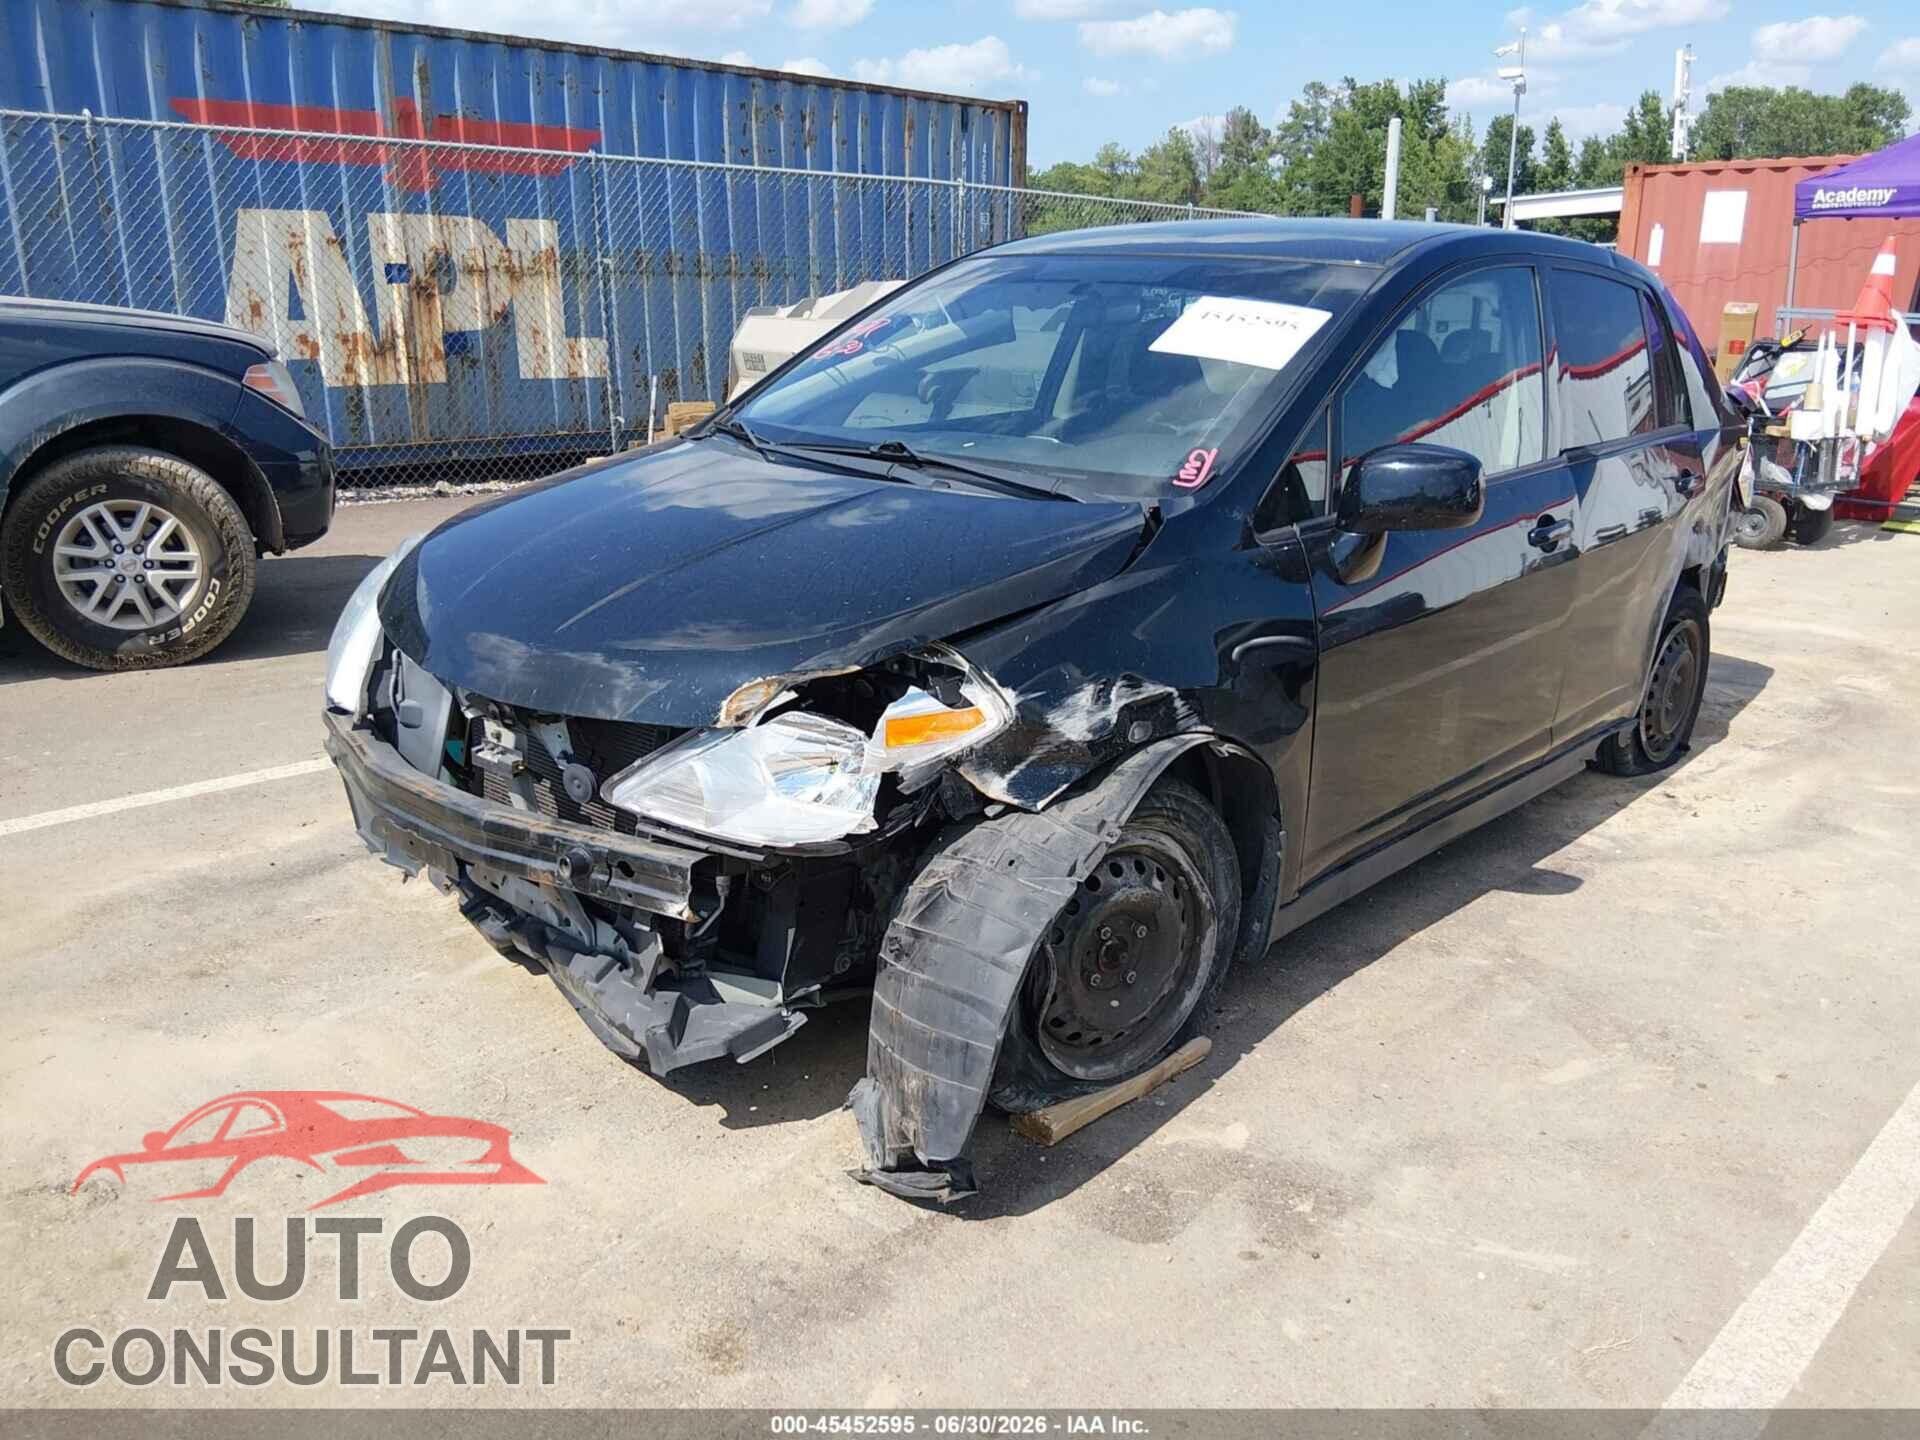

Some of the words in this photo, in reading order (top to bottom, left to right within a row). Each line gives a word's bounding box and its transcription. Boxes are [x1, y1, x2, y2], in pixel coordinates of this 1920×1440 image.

[1812, 187, 1893, 205] Academy
[225, 208, 609, 387] APL
[33, 483, 109, 555] COOPER
[149, 578, 221, 646] COOPER
